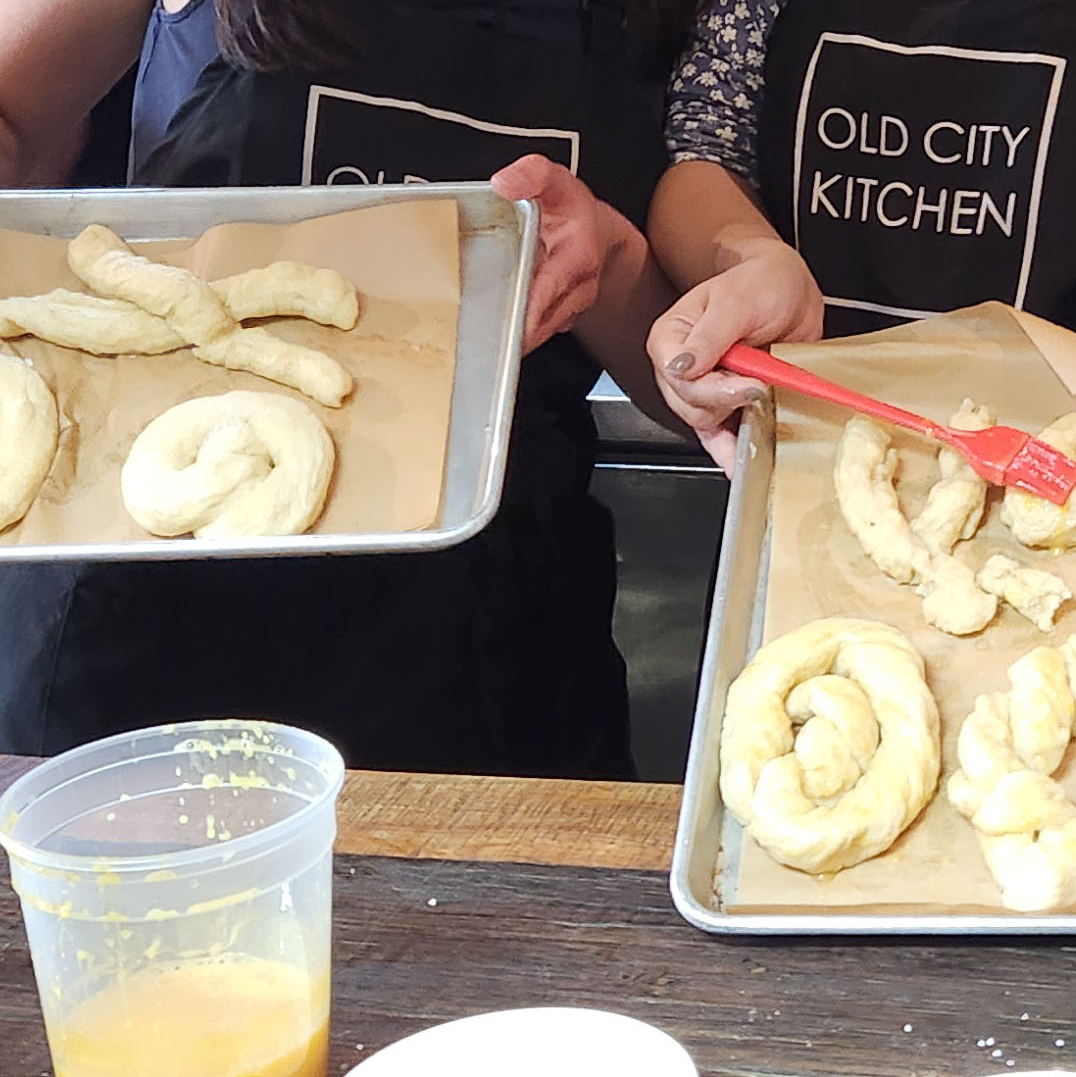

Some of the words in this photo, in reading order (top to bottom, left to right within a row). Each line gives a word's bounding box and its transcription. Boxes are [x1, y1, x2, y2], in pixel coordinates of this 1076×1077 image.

[817, 107, 909, 157] OLD
[923, 121, 1030, 168] CITY
[810, 170, 1017, 238] KITCHEN
